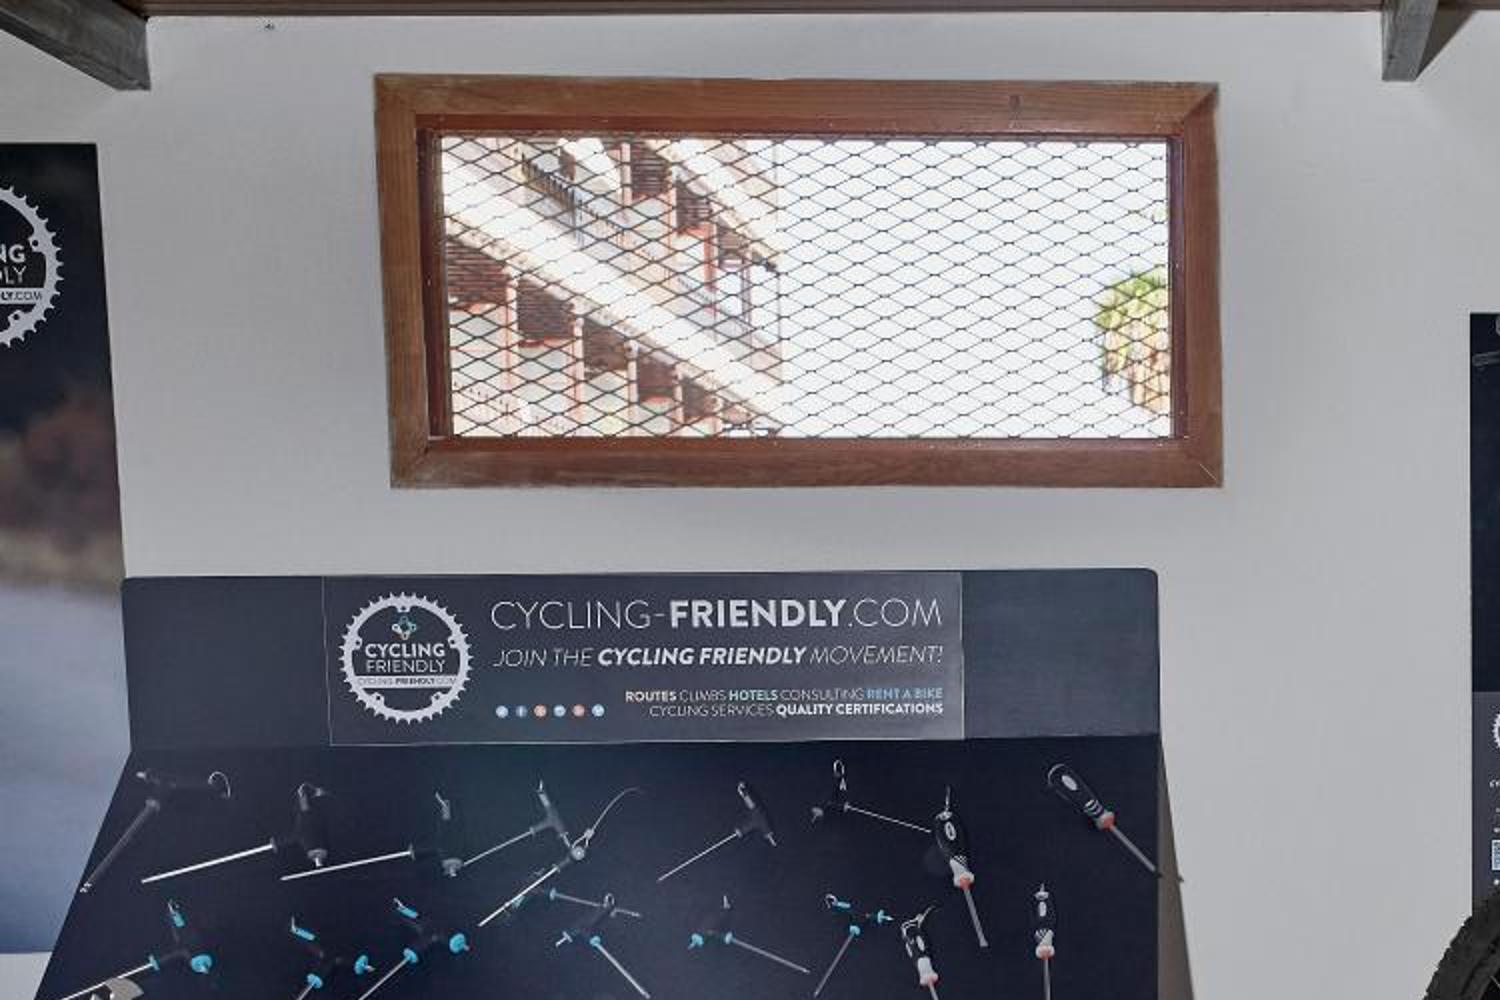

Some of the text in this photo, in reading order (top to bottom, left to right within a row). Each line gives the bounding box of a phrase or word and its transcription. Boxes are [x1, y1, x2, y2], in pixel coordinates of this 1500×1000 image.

[491, 598, 943, 630] CYCLING-FRIENDLY.COM
[365, 643, 446, 658] CYCLING
[492, 645, 944, 667] JOIN THE CYCLING FRIENDLY MOVEMENT!
[366, 659, 446, 674] FRIENDLY
[625, 691, 677, 703] ROUTES
[729, 689, 778, 701] HOTELS
[780, 688, 865, 701] CONSULTING
[867, 688, 899, 700] RENT
[901, 688, 912, 700] A
[914, 687, 943, 699] BIKE
[649, 702, 944, 717] CYCLING SERVICES QUALITY CERTIFICATIONS
